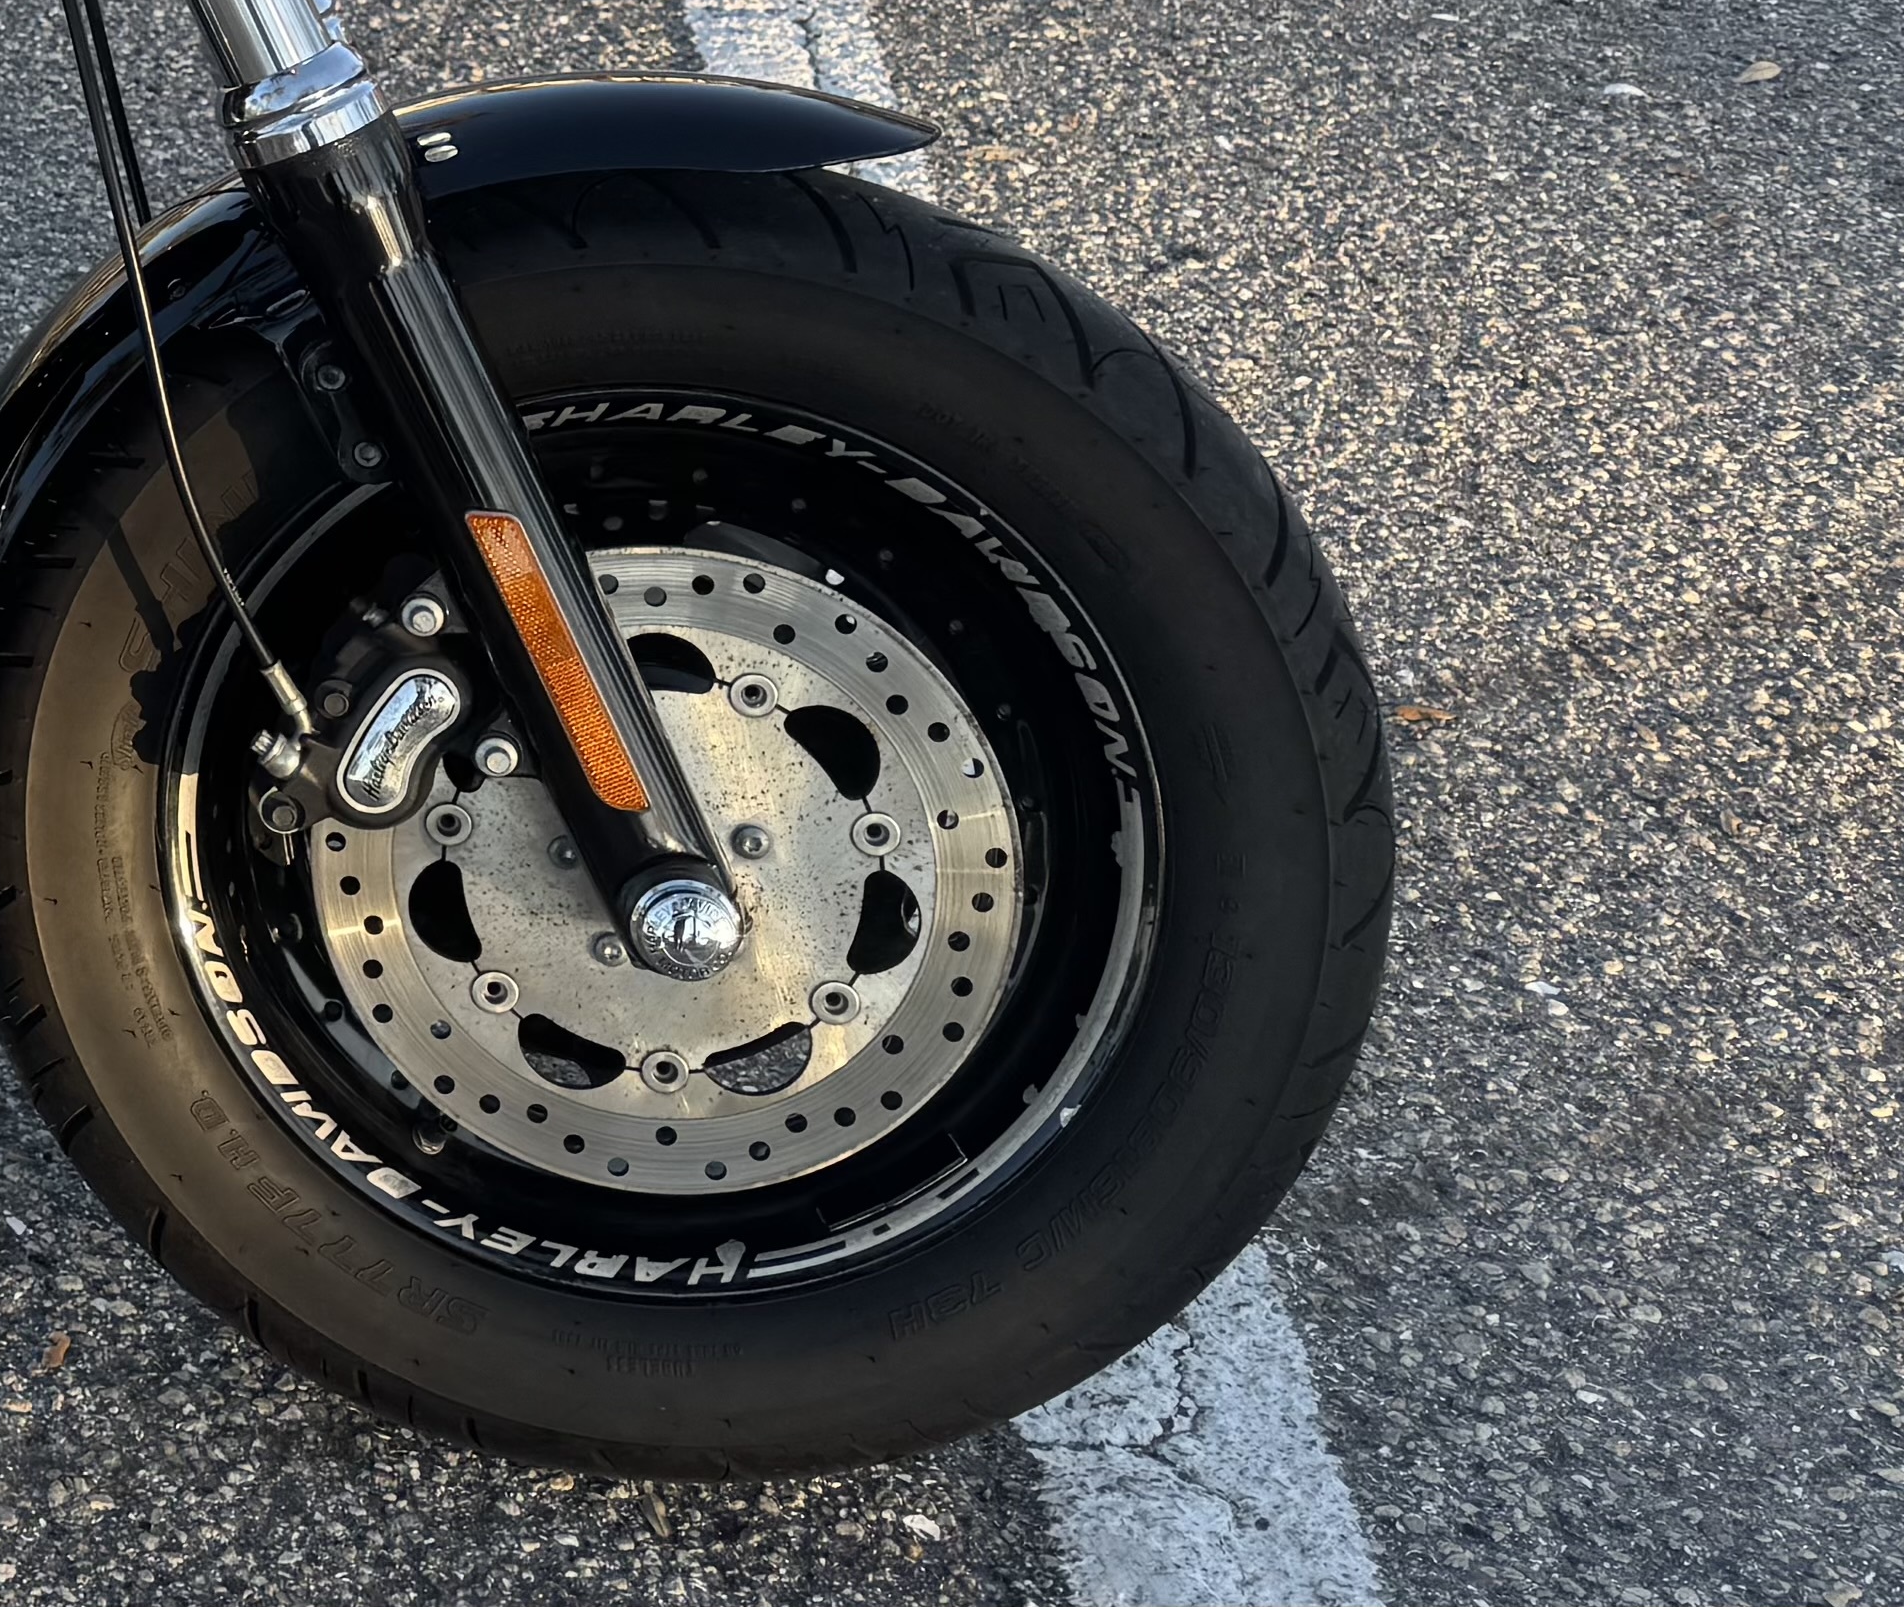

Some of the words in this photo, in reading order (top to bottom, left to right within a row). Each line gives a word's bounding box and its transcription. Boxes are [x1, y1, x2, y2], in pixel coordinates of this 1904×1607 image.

[361, 695, 437, 802] Harley-Davidson
[538, 401, 1138, 792] HARLEY-DAVIDSON
[190, 907, 748, 1286] HARLEY-DAVIDSON
